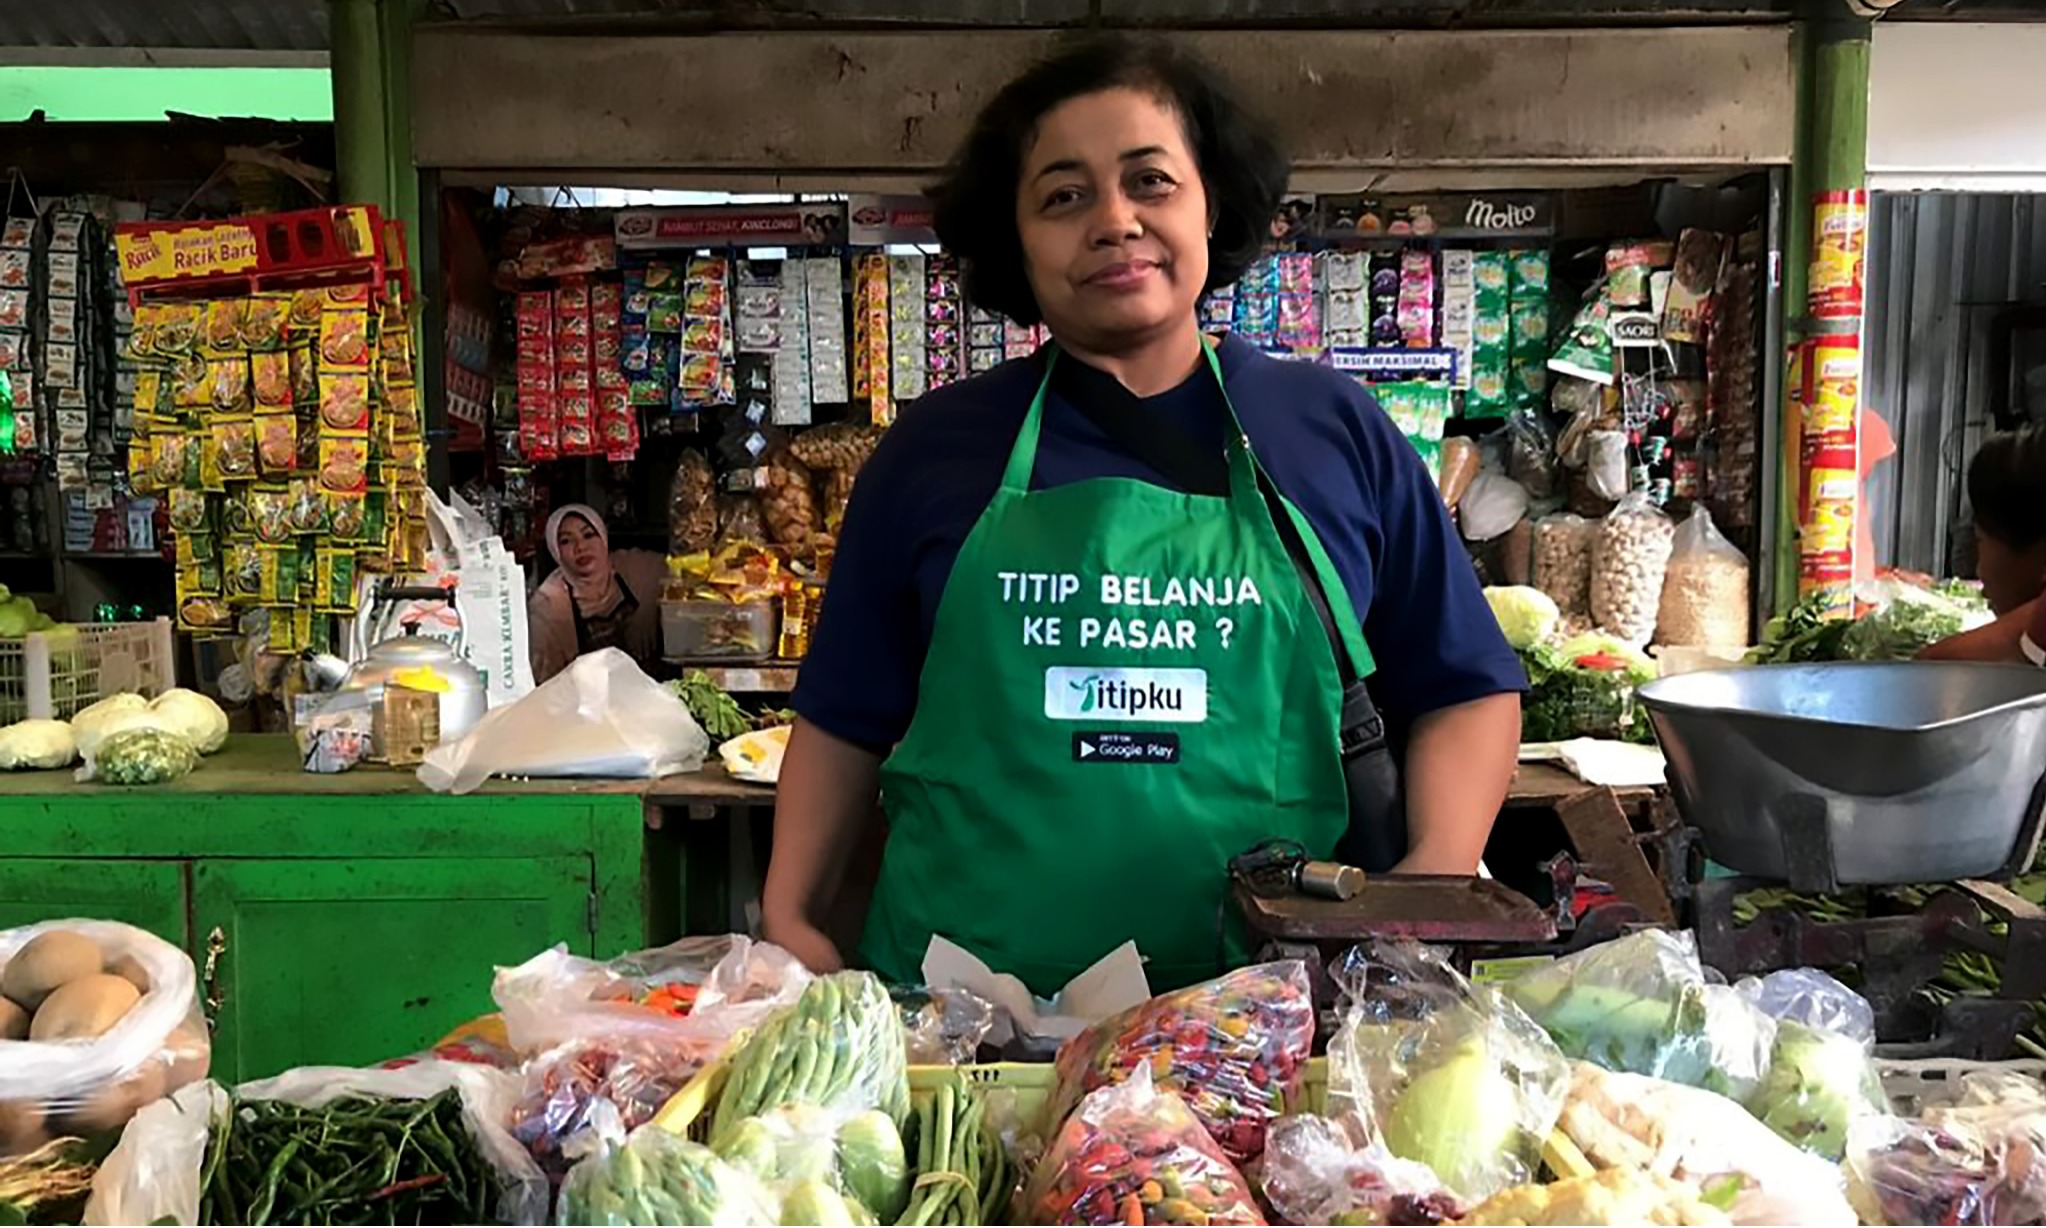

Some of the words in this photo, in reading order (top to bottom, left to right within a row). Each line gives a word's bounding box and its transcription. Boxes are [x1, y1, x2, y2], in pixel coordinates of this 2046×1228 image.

[1465, 199, 1536, 229] Molto
[174, 250, 217, 269] Racik
[1373, 355, 1437, 366] MAKSIMAL
[998, 572, 1080, 604] TITIP
[1101, 574, 1262, 607] BELANJA
[1023, 615, 1062, 646] KE
[1080, 617, 1197, 650] PASAR
[1215, 617, 1234, 649] ?
[1069, 675, 1182, 716] Titipku
[1099, 743, 1143, 759] Google
[1147, 743, 1174, 760] Play
